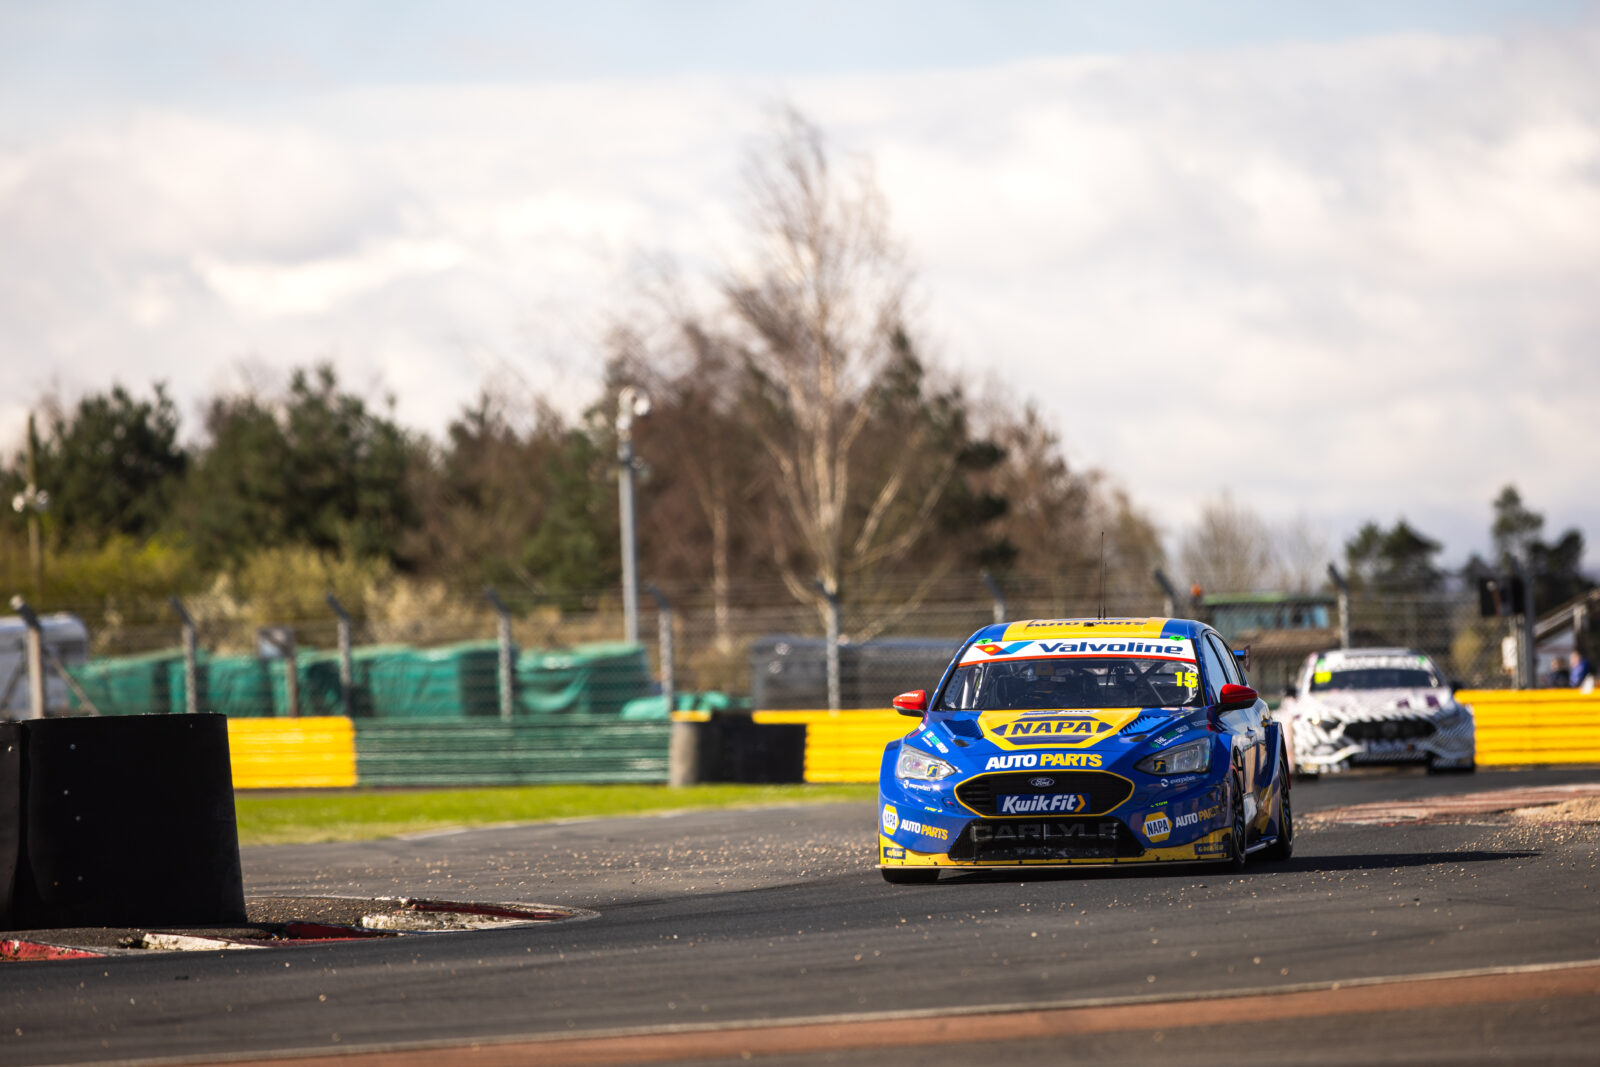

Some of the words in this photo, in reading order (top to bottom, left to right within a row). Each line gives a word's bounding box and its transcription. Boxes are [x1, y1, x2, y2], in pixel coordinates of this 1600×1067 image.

[1038, 641, 1184, 655] Valvoline
[1174, 671, 1198, 689] 15
[1010, 721, 1093, 736] NAPA
[985, 754, 1038, 770] AUTO
[1039, 753, 1103, 767] PARTS
[1146, 819, 1169, 836] NAPA
[1175, 813, 1199, 828] AUTO
[900, 819, 921, 834] AUTO
[921, 824, 949, 840] PARTS
[971, 822, 1119, 842] CARLYLE
